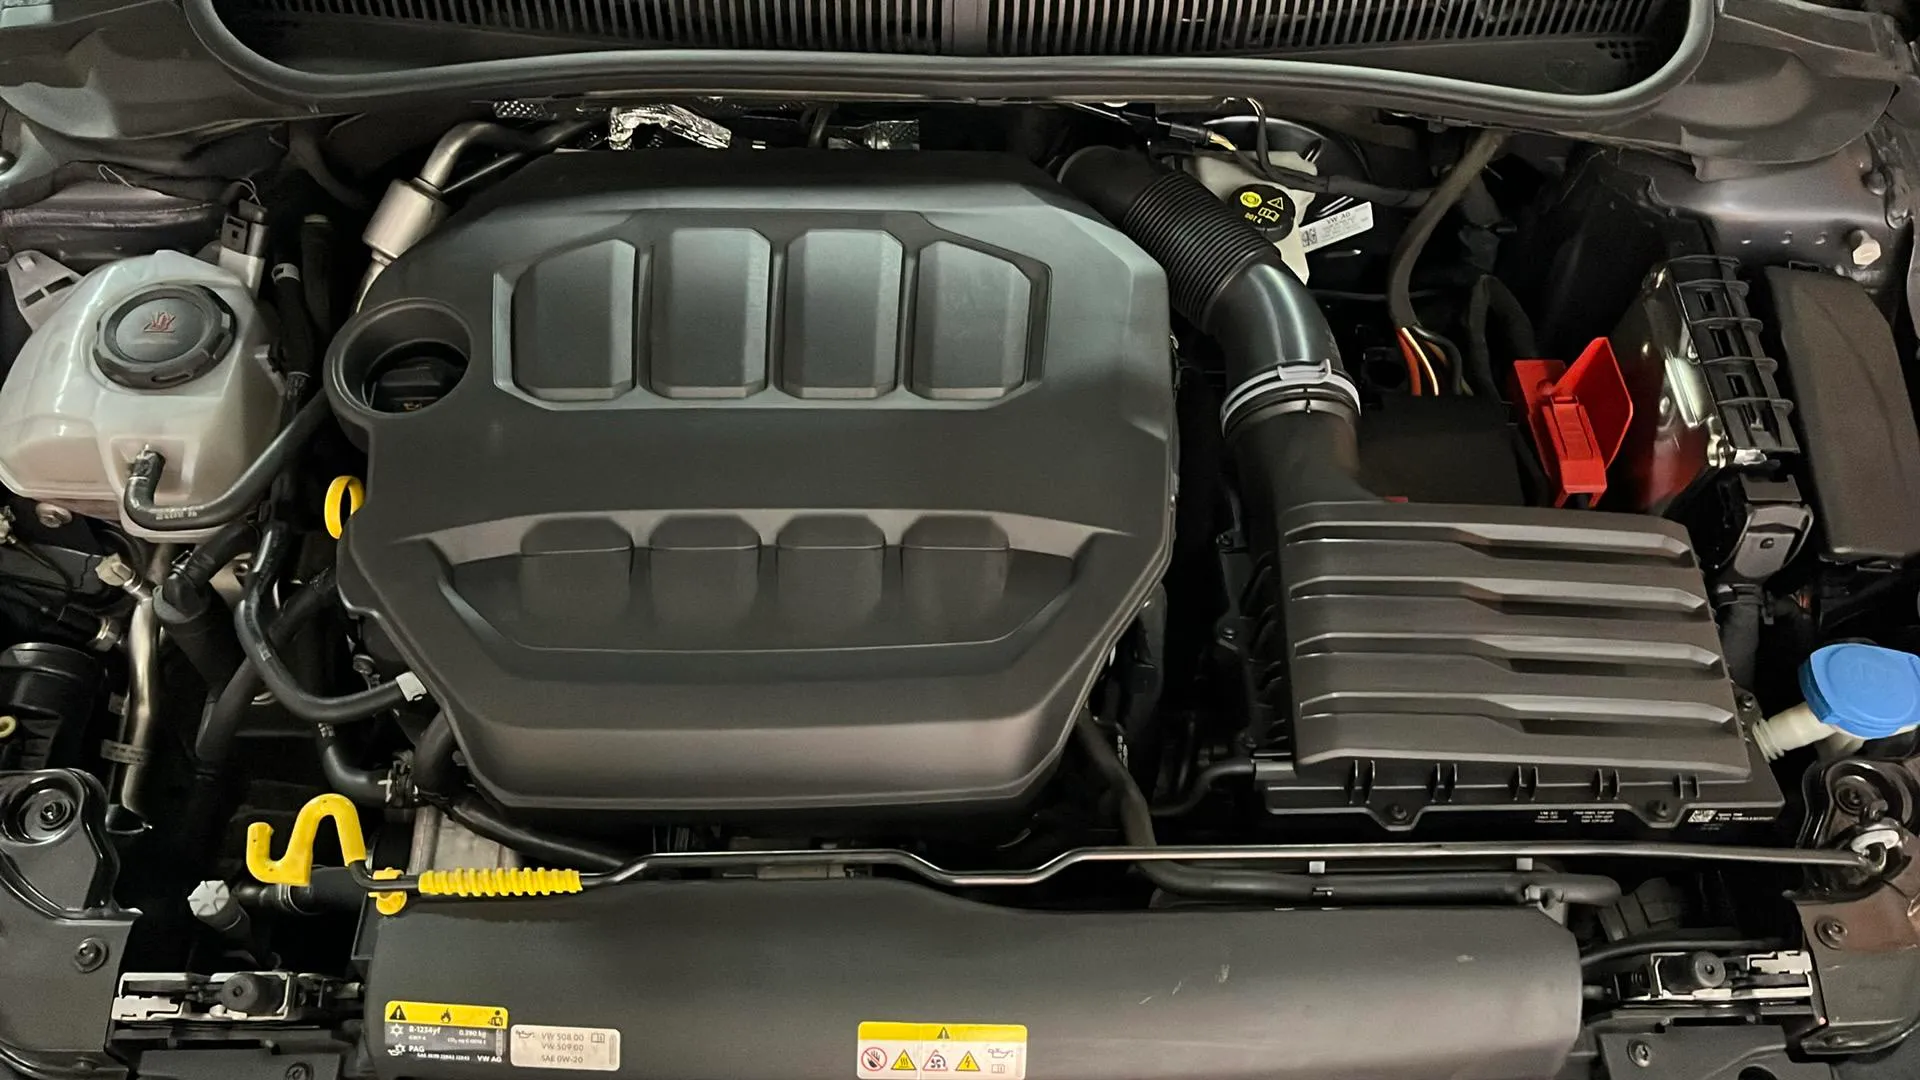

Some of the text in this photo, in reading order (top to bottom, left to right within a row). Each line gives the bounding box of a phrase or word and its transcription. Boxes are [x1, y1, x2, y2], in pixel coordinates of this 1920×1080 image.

[408, 1026, 441, 1036] R-1234yf
[556, 1033, 572, 1041] 508
[573, 1034, 585, 1042] 00
[408, 1045, 425, 1053] PAG
[541, 1042, 584, 1052] VW 509 00
[541, 1054, 584, 1064] SAE 0W-20
